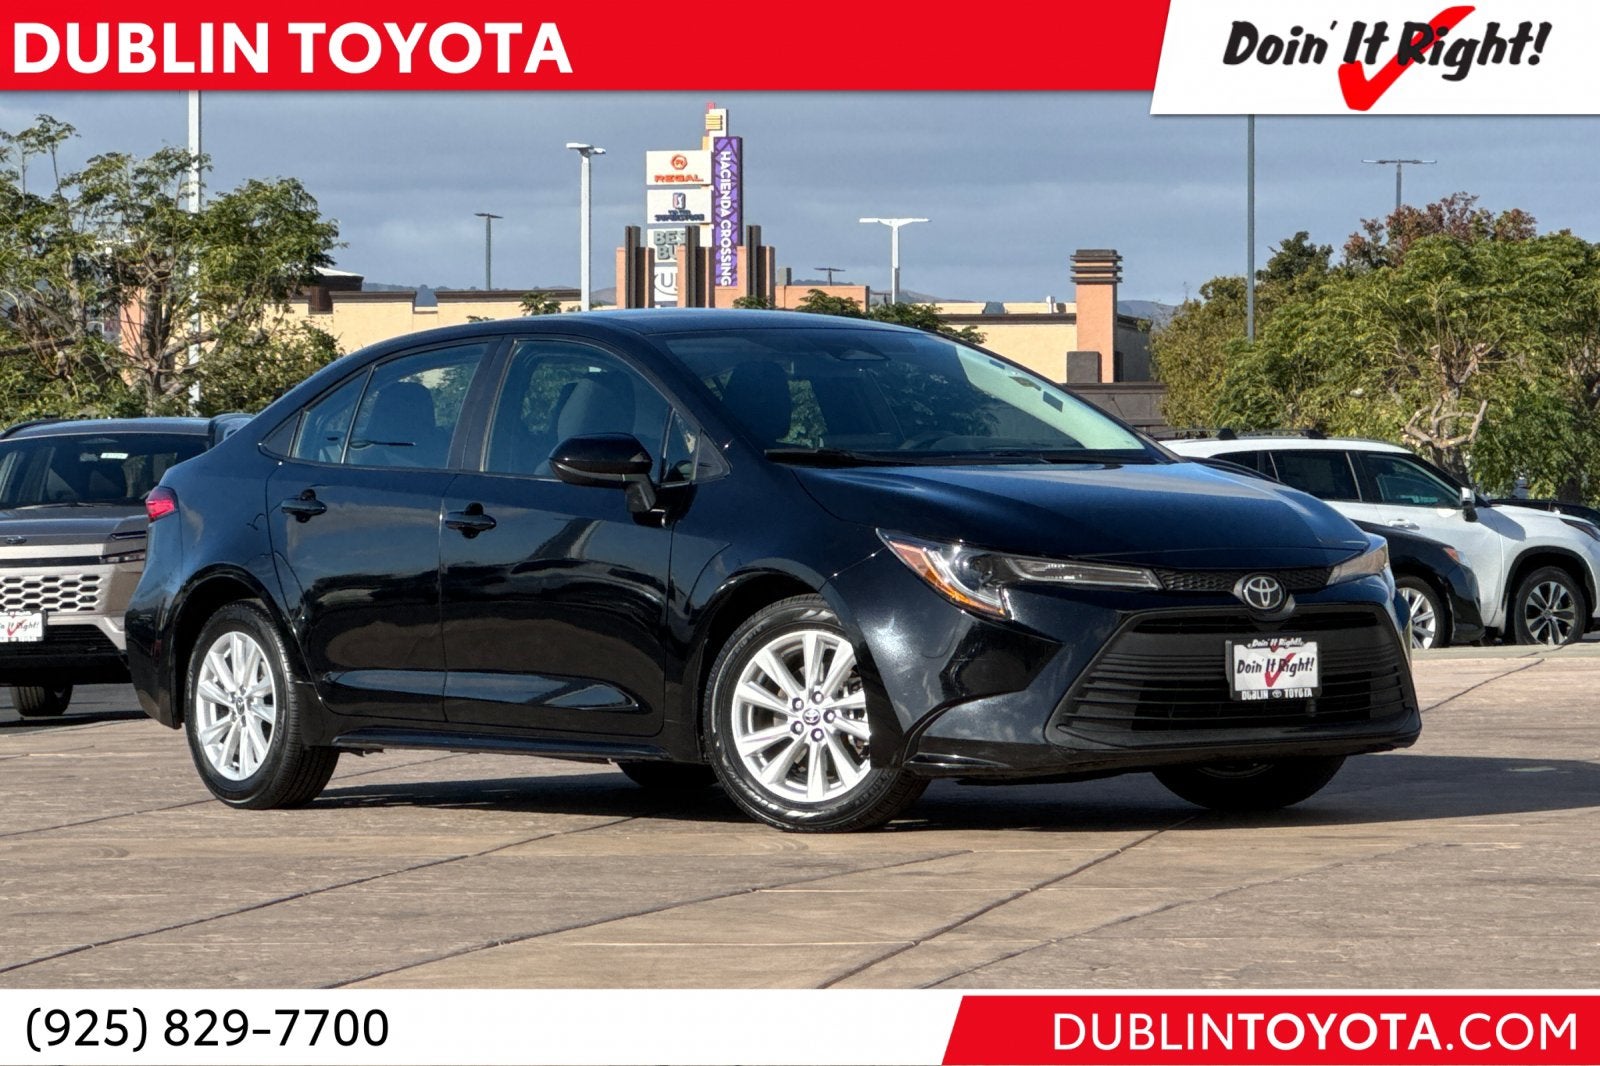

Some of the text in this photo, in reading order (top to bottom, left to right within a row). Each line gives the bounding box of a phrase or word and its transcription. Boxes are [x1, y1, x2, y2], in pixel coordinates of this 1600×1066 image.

[654, 174, 704, 183] REGAL
[720, 151, 732, 287] HACIENDA CROSSING
[654, 230, 686, 246] BES
[1265, 658, 1277, 673] It
[1278, 657, 1315, 678] Right!
[1283, 687, 1313, 699] TOYOTA
